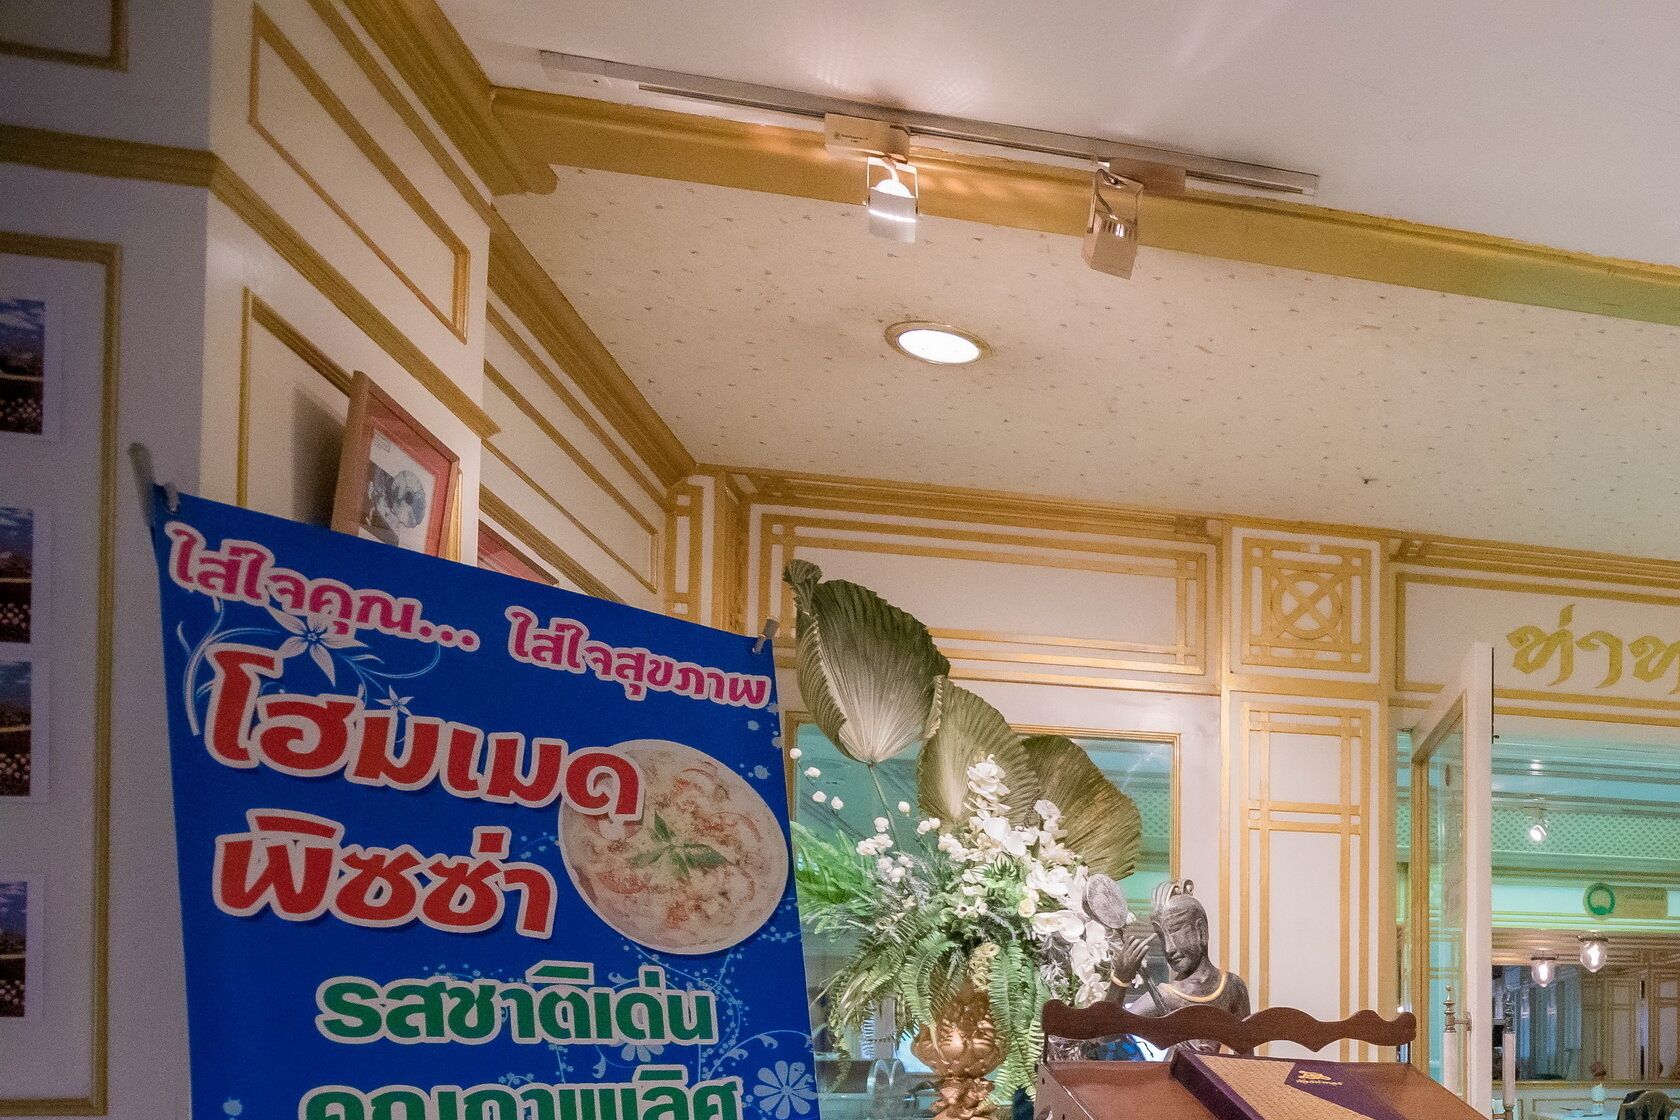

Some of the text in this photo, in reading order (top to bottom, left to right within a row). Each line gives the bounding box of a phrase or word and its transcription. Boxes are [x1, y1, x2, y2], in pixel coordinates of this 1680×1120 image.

[507, 608, 770, 707] ใส่ใจสุขภาพ
[208, 646, 643, 818] โฮมเมด
[216, 811, 556, 936] พิซซ่า
[320, 963, 716, 1042] รสชาติเด่น
